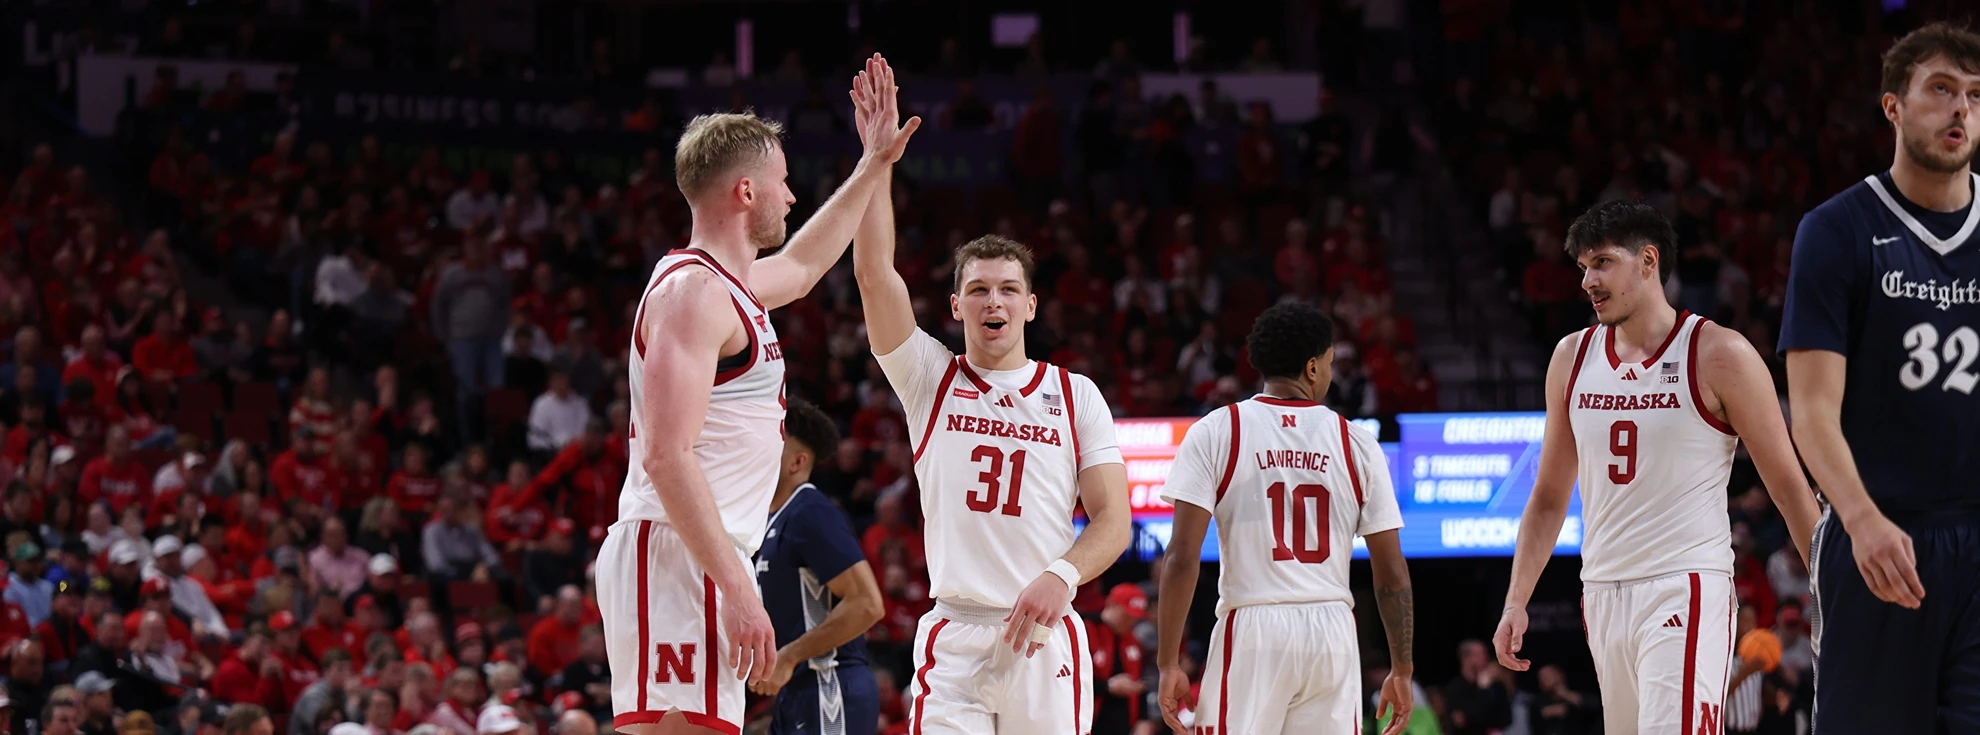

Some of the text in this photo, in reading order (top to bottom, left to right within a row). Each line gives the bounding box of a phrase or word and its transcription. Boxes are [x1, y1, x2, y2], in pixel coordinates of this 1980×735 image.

[1898, 322, 1980, 395] 32
[1578, 393, 1681, 411] NEBRASKA
[946, 414, 1062, 447] NEBRASKA
[1281, 415, 1297, 428] N
[1256, 449, 1330, 473] LAWRENCE
[1608, 420, 1638, 485] 9
[966, 444, 1027, 518] 31
[1266, 481, 1331, 564] 10
[655, 642, 697, 685] N
[1697, 701, 1719, 735] N
